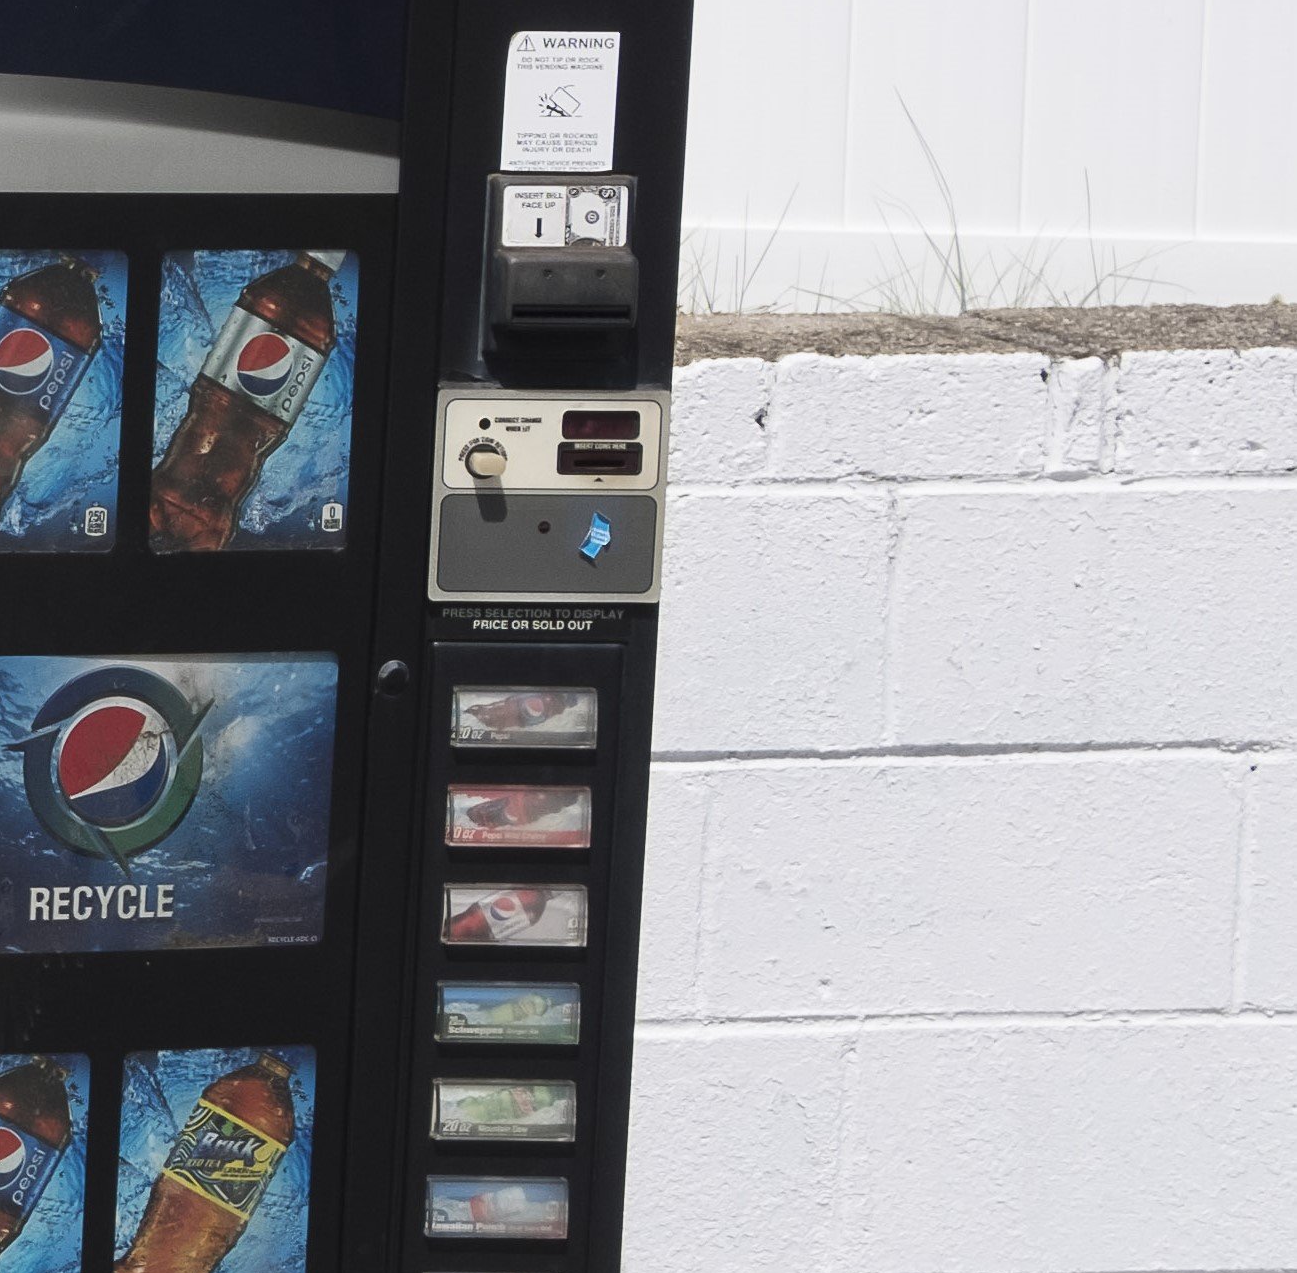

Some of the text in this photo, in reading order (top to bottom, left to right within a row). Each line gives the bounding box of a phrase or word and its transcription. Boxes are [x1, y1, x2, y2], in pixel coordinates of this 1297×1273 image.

[543, 38, 615, 49] WARNING
[39, 350, 74, 411] pepsi
[281, 355, 313, 413] pepsi
[442, 608, 625, 619] PRESS SELECTION TO DISPLAY
[473, 620, 593, 630] PRICE OR SOLD OUT
[29, 884, 174, 920] RECYCLE
[12, 1146, 44, 1206] pepsi
